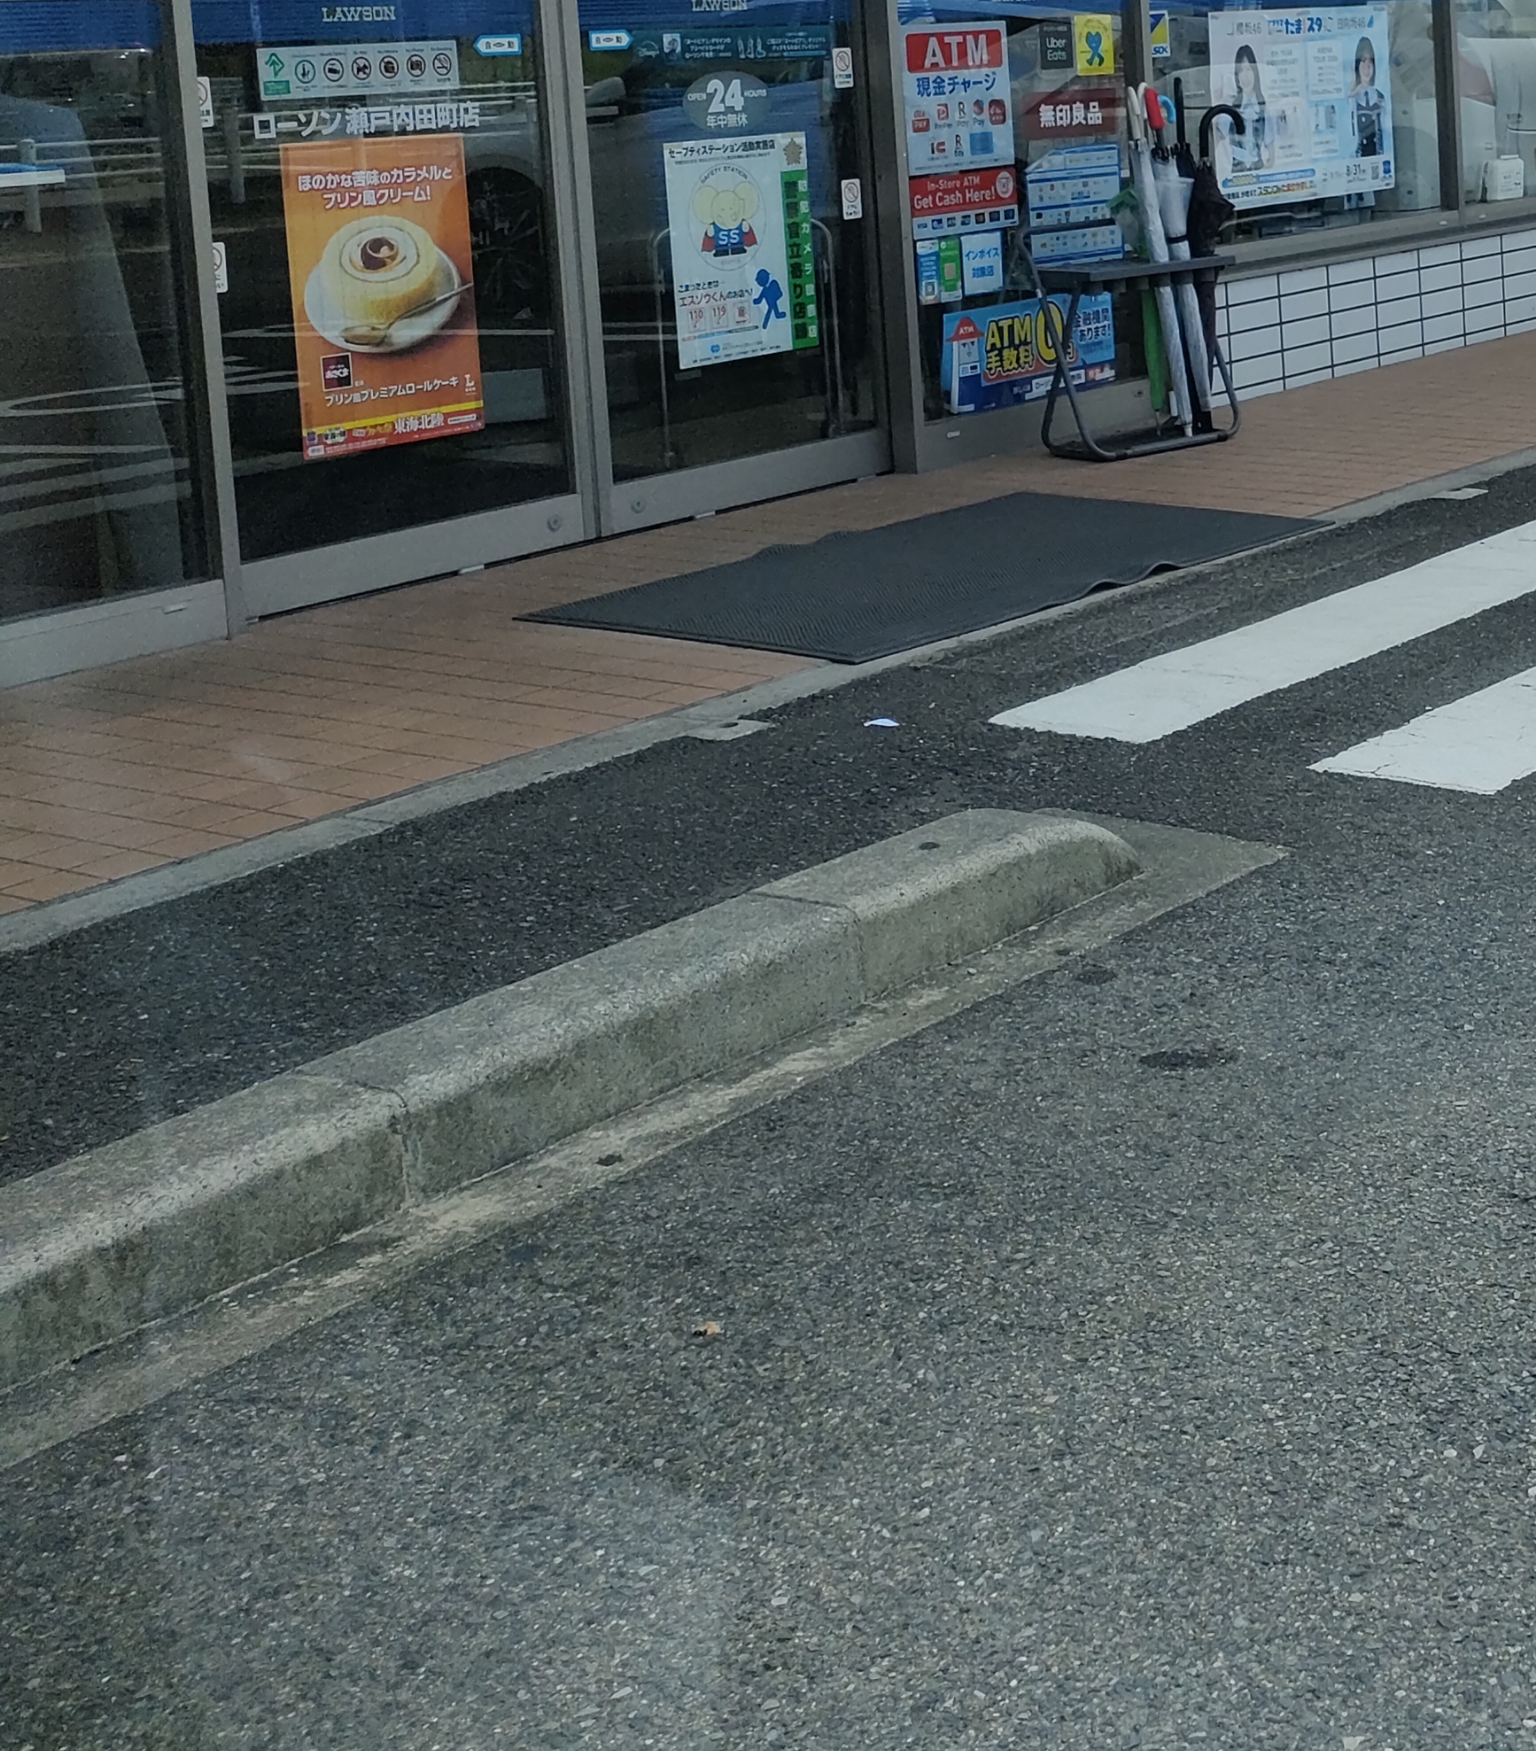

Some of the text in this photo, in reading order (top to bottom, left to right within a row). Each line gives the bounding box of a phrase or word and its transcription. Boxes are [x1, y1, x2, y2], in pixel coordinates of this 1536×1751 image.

[321, 6, 396, 22] LAWSON
[923, 33, 989, 69] ATM
[1046, 37, 1067, 49] Uber
[1047, 49, 1067, 61] Eats
[916, 71, 996, 98] 現金チャージ
[687, 79, 768, 113] OPEN 24 HOURS
[706, 113, 748, 128] 年中無休
[1039, 101, 1102, 128] 無印良品
[927, 175, 980, 191] In-Store ATM
[914, 186, 995, 210] Get Cash Here!
[718, 230, 740, 245] SS
[959, 325, 975, 336] ATM
[985, 313, 1032, 351] ATM
[985, 342, 1034, 375] 手数料
